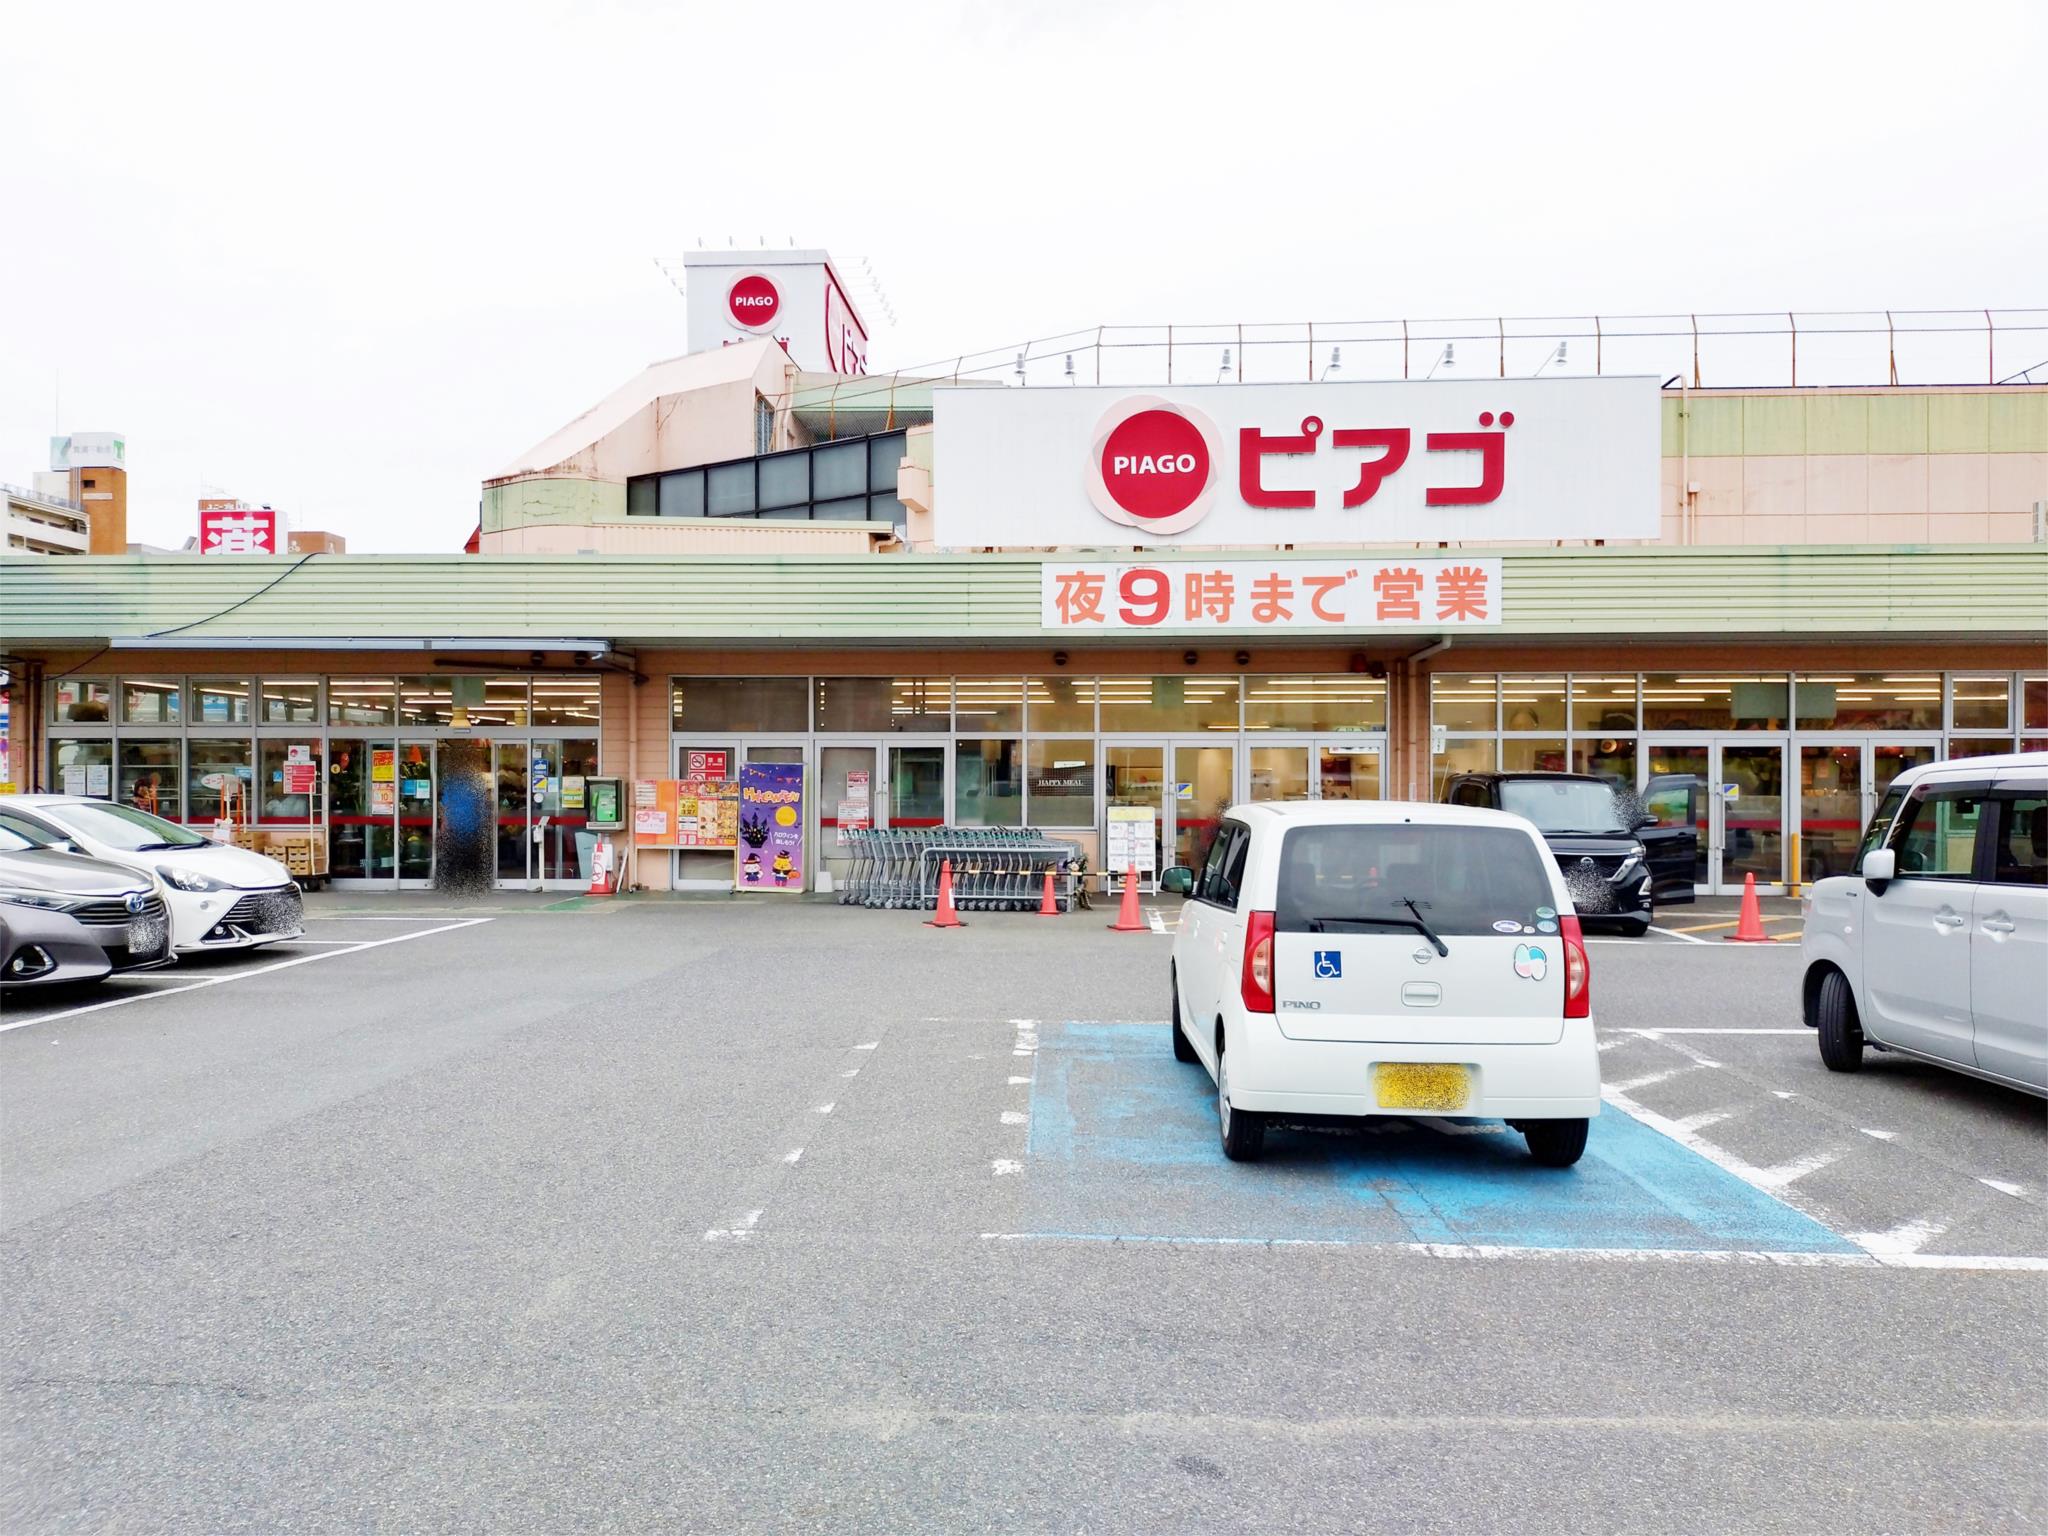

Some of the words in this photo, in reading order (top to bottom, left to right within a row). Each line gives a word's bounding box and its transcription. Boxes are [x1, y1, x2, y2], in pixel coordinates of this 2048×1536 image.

[735, 296, 774, 306] PIAGO
[1114, 453, 1196, 475] PIAGO
[1239, 411, 1514, 508] ピアゴ
[204, 516, 271, 554] 薬
[1055, 566, 1488, 625] 夜9時まで営業
[1038, 779, 1062, 787] HAPPY
[1063, 779, 1084, 787] MEAL
[743, 786, 800, 804] HALLOWEEN
[1282, 1000, 1321, 1010] PINO
